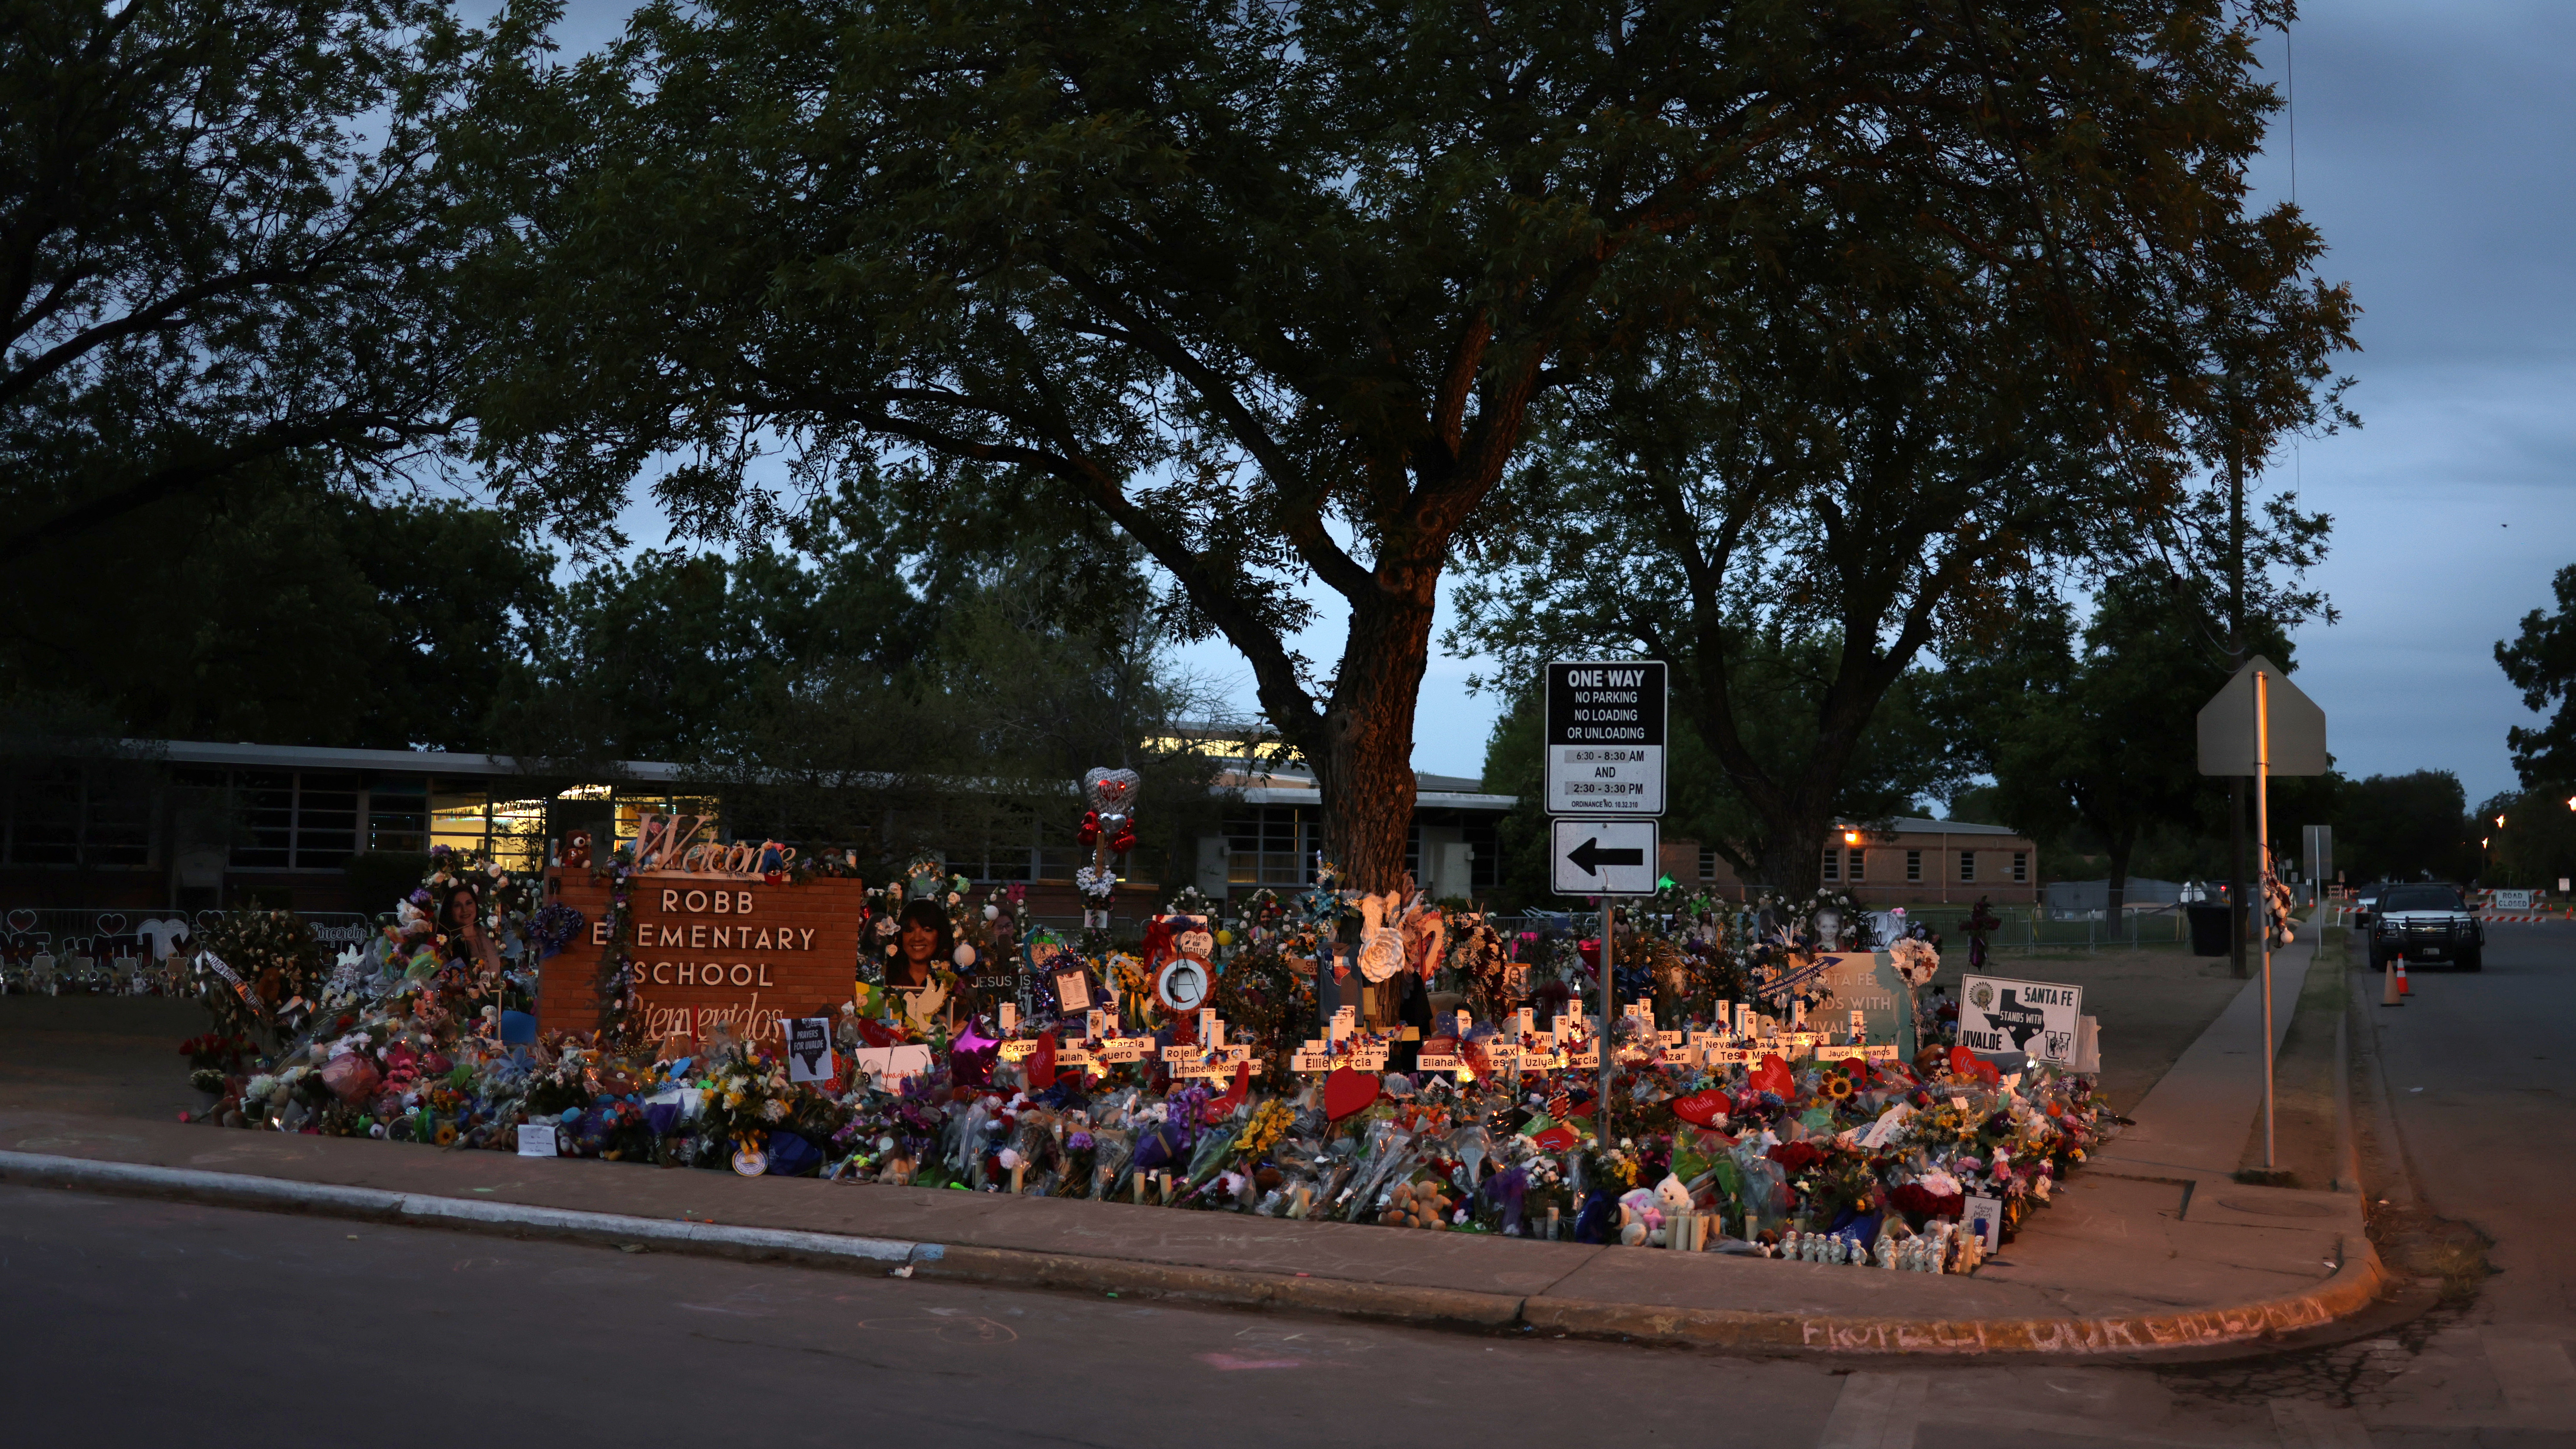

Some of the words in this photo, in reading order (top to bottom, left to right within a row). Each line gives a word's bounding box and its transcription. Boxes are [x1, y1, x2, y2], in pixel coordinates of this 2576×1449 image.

[1568, 670, 1603, 687] ONE
[1608, 670, 1645, 687] WAY
[1575, 691, 1590, 703] NO
[1593, 691, 1637, 703] PARKING
[1575, 709, 1589, 721] NO
[1592, 709, 1638, 721] LOADING
[1567, 727, 1582, 739] OR
[1585, 727, 1645, 739] UNLOADING
[1576, 751, 1594, 760] 6:30
[1604, 751, 1626, 760] 8:30
[1629, 750, 1644, 762] AM
[1595, 767, 1616, 778] AND
[1573, 784, 1595, 793] 2:30
[1604, 784, 1626, 793] 3:30
[1629, 783, 1643, 795] PM
[634, 813, 797, 873] Welcome
[662, 889, 753, 914] ROBB
[309, 922, 366, 945] Sincerely
[592, 922, 815, 950] EEMENTARY
[209, 956, 225, 973] ZAPATA
[1784, 974, 1797, 982] WITH
[1795, 968, 1807, 976] YOU
[1807, 957, 1825, 971] UVALDE
[1818, 963, 1830, 972] UNIT
[223, 969, 245, 989] COUNTY
[634, 961, 773, 987] SCHOOL
[1857, 972, 1873, 986] FE
[971, 975, 1012, 988] JESUS
[1020, 975, 1031, 986] IS
[1850, 996, 1891, 1010] WITH
[2025, 987, 2057, 1005] SANTA
[2060, 991, 2073, 1007] FE
[2000, 1010, 2024, 1023] STANDS
[2026, 1013, 2042, 1025] WITH
[1808, 1020, 1868, 1034] UVALE
[797, 1029, 819, 1040] PRAYERS
[1963, 1030, 2003, 1051] UVALDE
[794, 1041, 804, 1051] FOR
[805, 1039, 824, 1050] UVALDE
[1006, 1044, 1037, 1053] Cazar
[1055, 1053, 1083, 1062] Jailah
[1089, 1051, 1132, 1061] Siguero
[1167, 1049, 1202, 1060] Rojelio
[1721, 1051, 1740, 1061] Tes
[1828, 1050, 1849, 1058] Jayce
[1306, 1058, 1329, 1068] Ellie
[1335, 1057, 1371, 1067] Grcia
[1473, 1059, 1505, 1067] orres
[1526, 1058, 1556, 1068] Uziya
[1572, 1056, 1598, 1065] arcia
[1173, 1065, 1216, 1074] Annabelle
[1219, 1063, 1262, 1072] Rodruez
[1975, 1203, 1993, 1213] always
